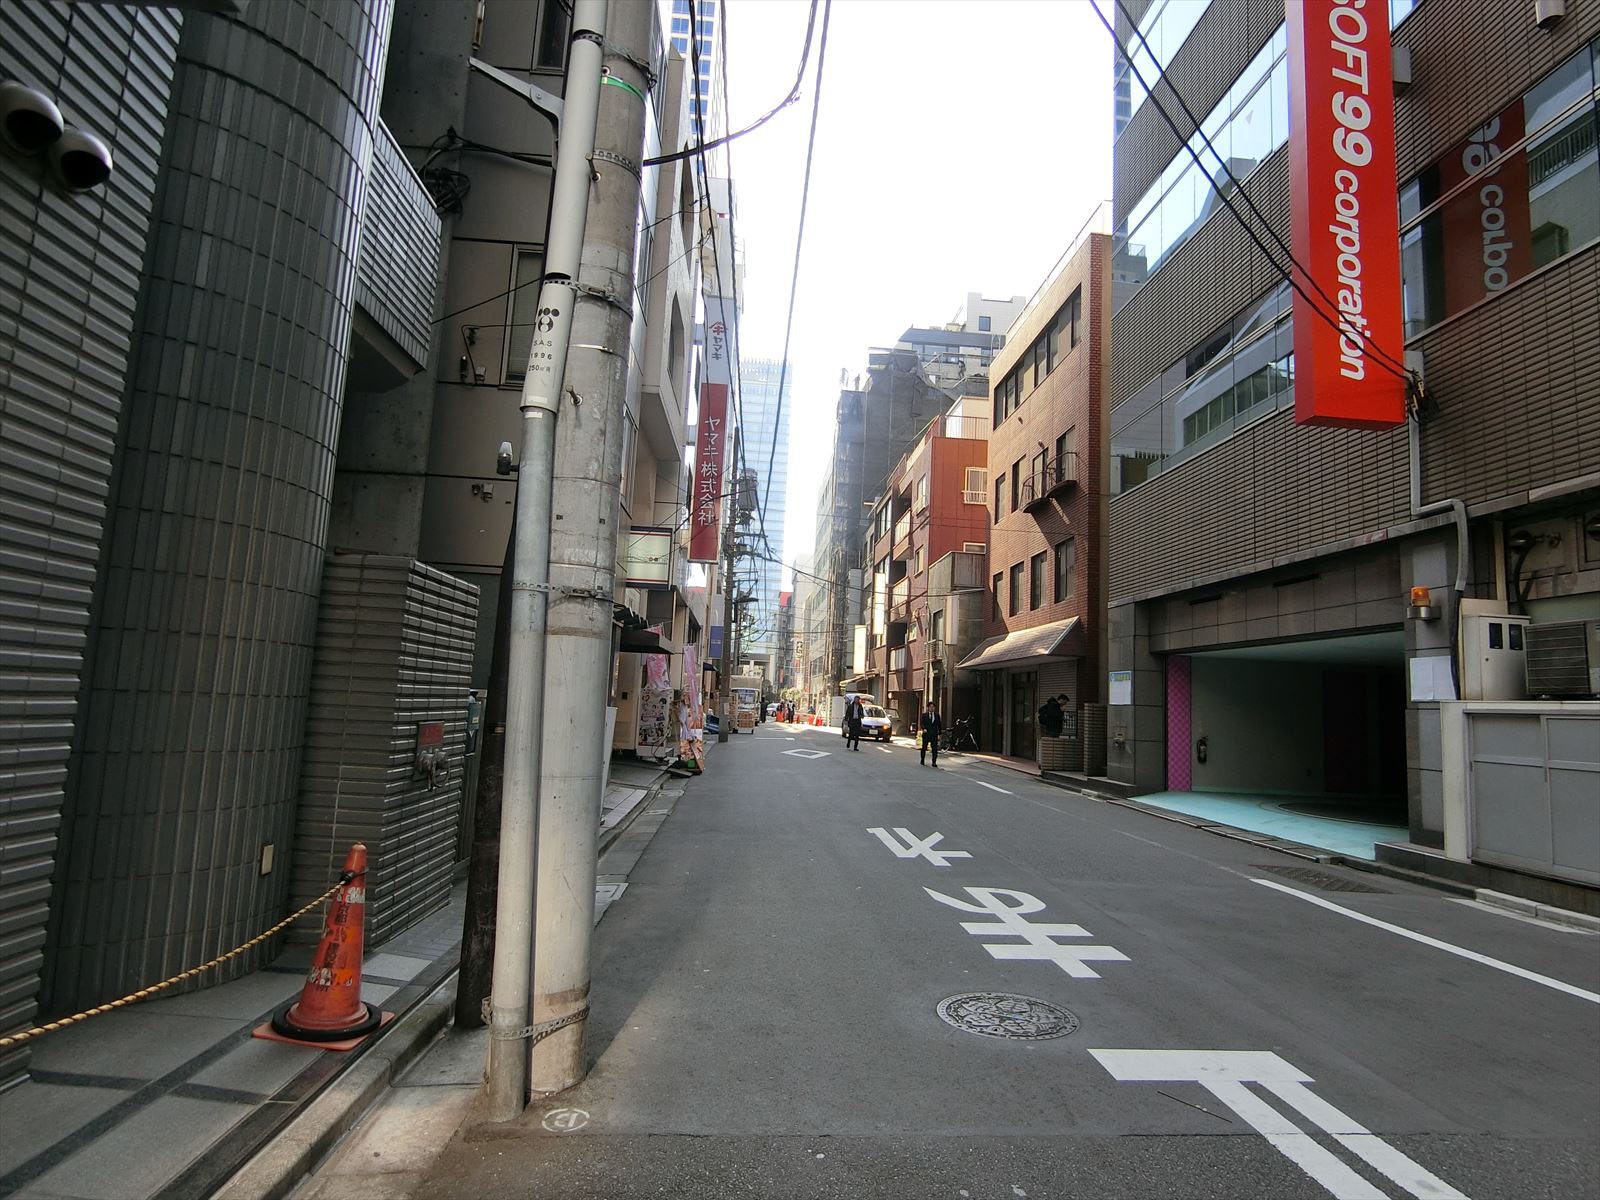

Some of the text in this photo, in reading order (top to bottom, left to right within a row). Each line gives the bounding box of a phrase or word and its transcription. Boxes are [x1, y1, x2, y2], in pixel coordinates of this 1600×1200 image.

[1327, 0, 1372, 382] OFT99 corporation
[711, 336, 723, 361] ヤマキ
[698, 416, 720, 527] ヤマキ株式会社
